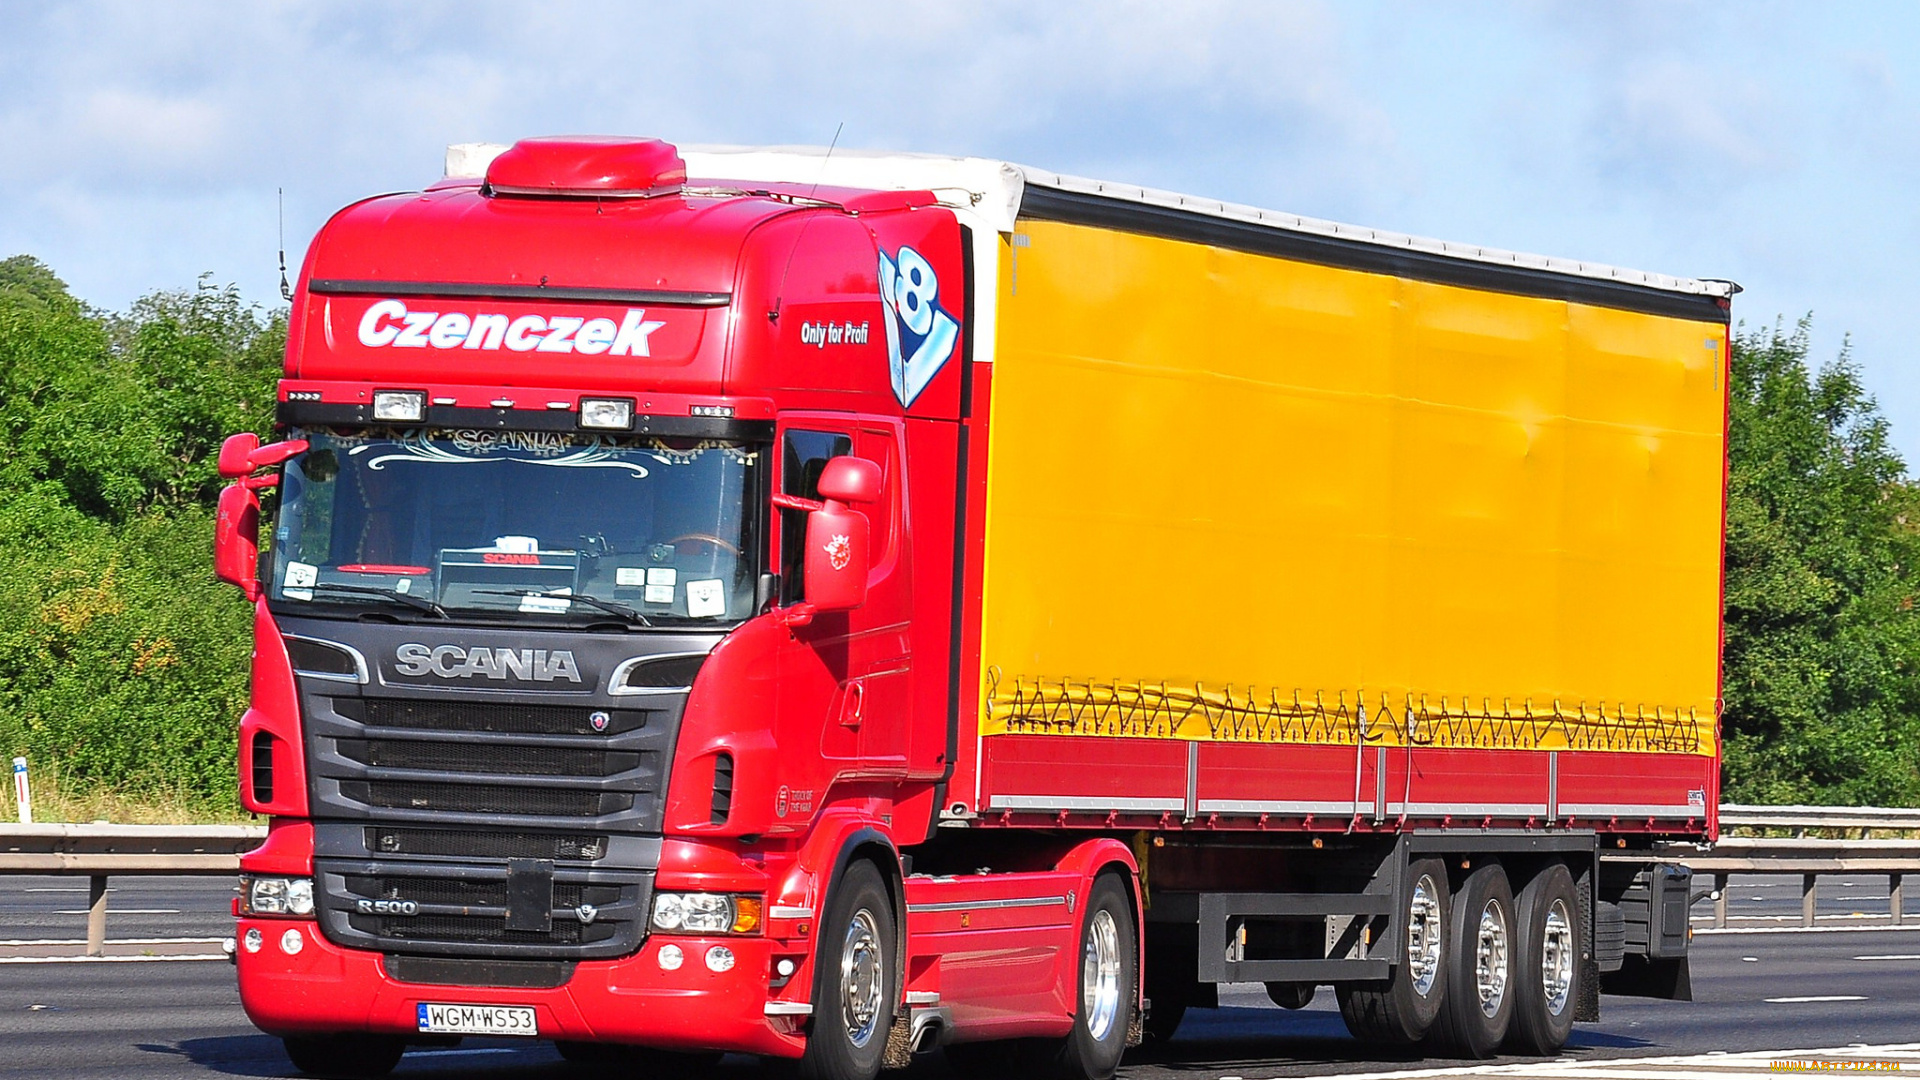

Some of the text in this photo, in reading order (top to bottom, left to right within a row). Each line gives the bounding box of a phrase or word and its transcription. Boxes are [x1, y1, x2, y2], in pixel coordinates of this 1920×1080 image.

[358, 298, 667, 357] Czenczek
[801, 320, 869, 349] Only for Profi
[453, 429, 566, 453] SCANIA
[482, 553, 540, 566] SCANIA
[395, 643, 582, 683] SCANIA
[431, 1007, 532, 1028] WGM WS53
